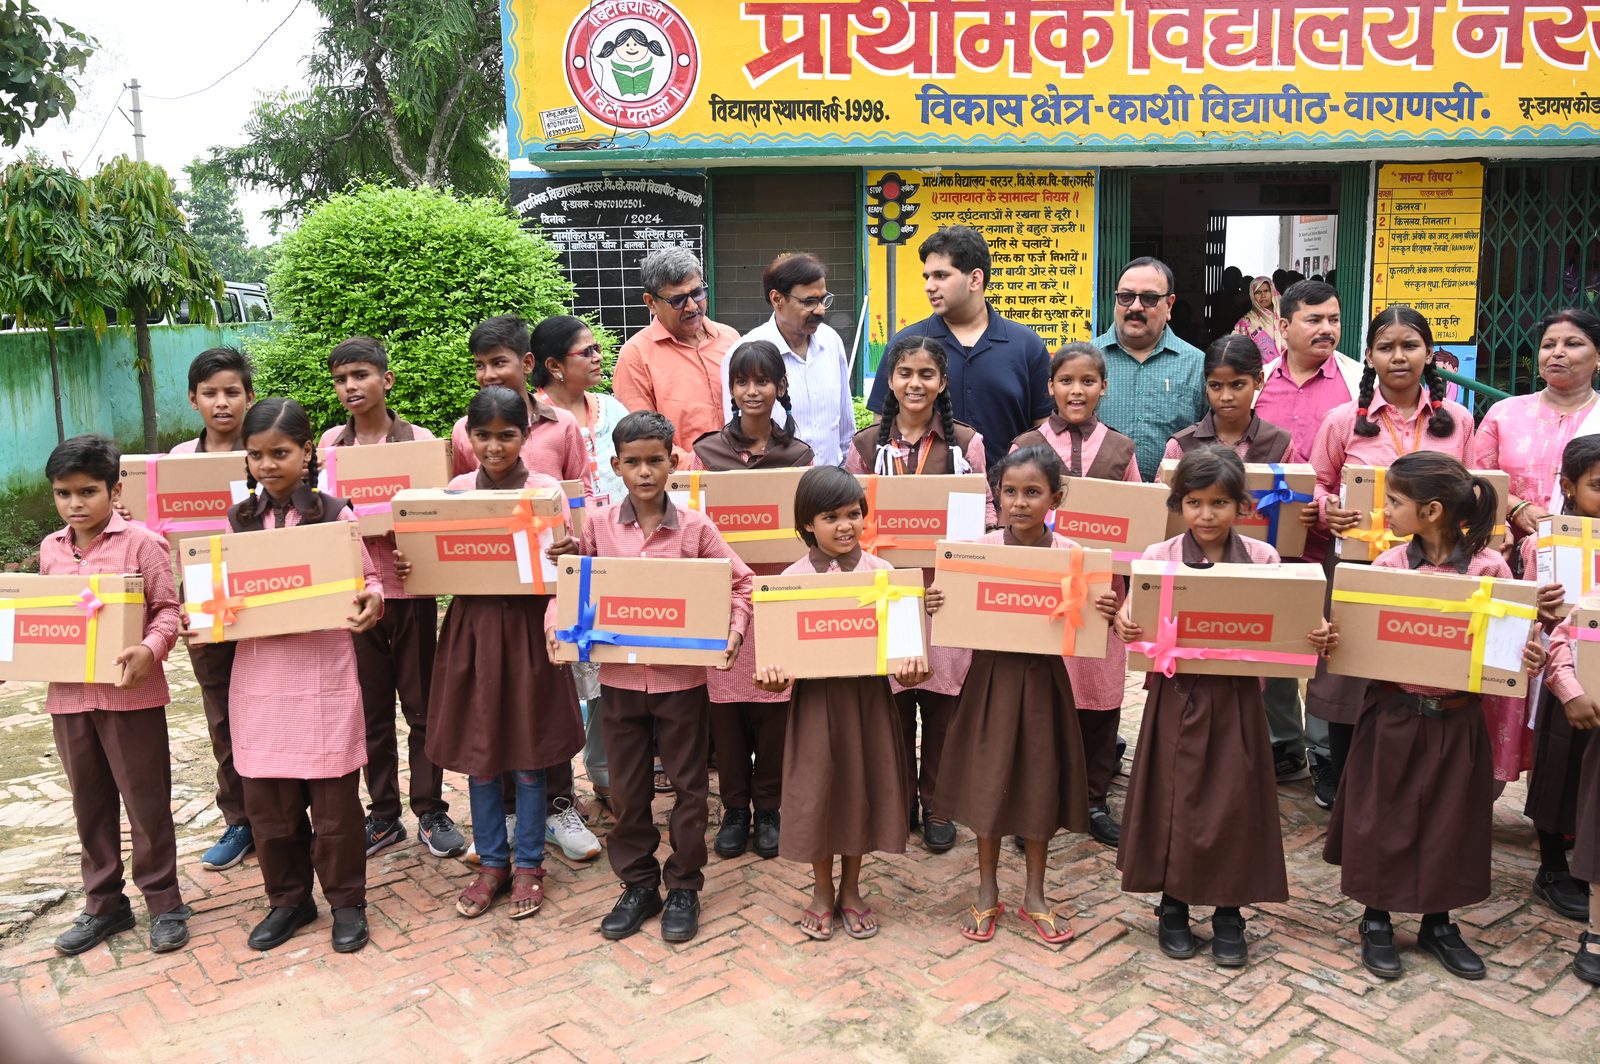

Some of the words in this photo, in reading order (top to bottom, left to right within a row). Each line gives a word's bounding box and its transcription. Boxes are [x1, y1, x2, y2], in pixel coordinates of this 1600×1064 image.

[1455, 0, 1600, 69] नर
[708, 94, 773, 128] विद्यालय
[773, 99, 825, 125] स्थापना
[915, 84, 1028, 127] विकास
[939, 192, 985, 205] यातायात
[986, 188, 997, 203] के
[998, 192, 1040, 204] सामान्य
[1042, 188, 1070, 203] नियम
[931, 211, 955, 221] अगर
[1004, 208, 1013, 220] से
[1015, 210, 1041, 219] रखना
[1054, 207, 1071, 221] दूरी
[1380, 203, 1386, 212] 1
[1396, 203, 1422, 212] कलरव
[1379, 216, 1386, 226] 2
[870, 226, 879, 234] GO
[985, 224, 1014, 234] लगाना
[1026, 224, 1048, 236] बहुत
[1009, 237, 1018, 249] से
[1378, 237, 1385, 248] 3
[1428, 232, 1436, 240] का
[1013, 253, 1025, 263] का
[1028, 264, 1046, 276] ओर
[1048, 264, 1057, 276] से
[1007, 282, 1024, 291] पार
[1026, 282, 1037, 290] ना
[1004, 296, 1016, 305] का
[1018, 296, 1047, 305] पालन
[1004, 307, 1030, 319] परिवार
[1031, 307, 1042, 319] की
[1434, 314, 1460, 329] प्रकृति
[341, 482, 404, 500] Lenovo
[162, 498, 226, 513] Lenovo
[710, 511, 772, 526] Lenovo
[878, 515, 941, 529] Lenovo
[1058, 516, 1122, 537] Lenovo
[443, 540, 511, 556] Lenovo
[953, 553, 986, 561] chromebook
[234, 574, 305, 595] Lenovo
[985, 588, 1058, 609] Lenovo
[607, 602, 679, 621] Lenovo
[20, 621, 80, 637] Lenovo
[805, 617, 875, 633] Lenovo
[1185, 617, 1265, 635] Lenovo
[1387, 619, 1470, 645] Lenovo
